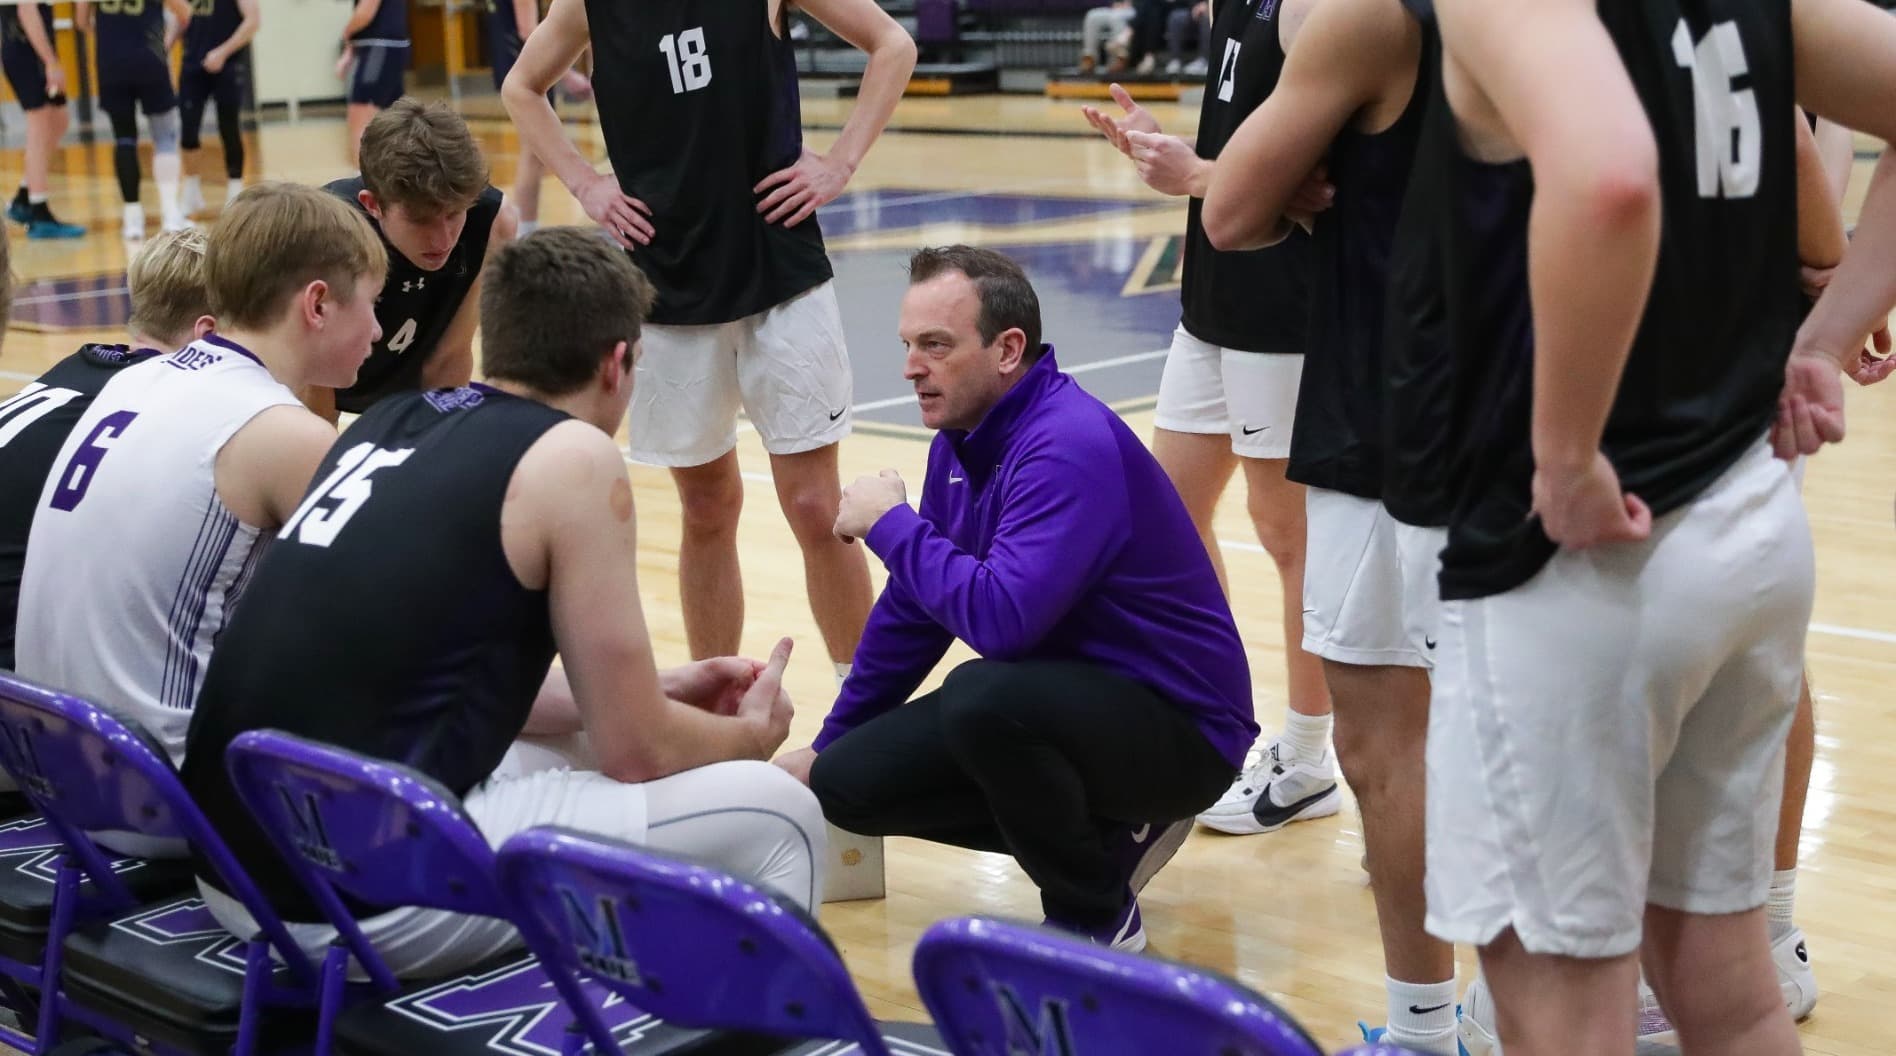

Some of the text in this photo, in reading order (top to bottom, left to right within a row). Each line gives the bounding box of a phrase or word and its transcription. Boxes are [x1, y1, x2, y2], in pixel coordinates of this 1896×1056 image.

[659, 26, 712, 93] 18
[1671, 17, 1761, 198] 16
[387, 318, 417, 354] 4
[49, 409, 139, 512] 6
[277, 441, 416, 547] 15
